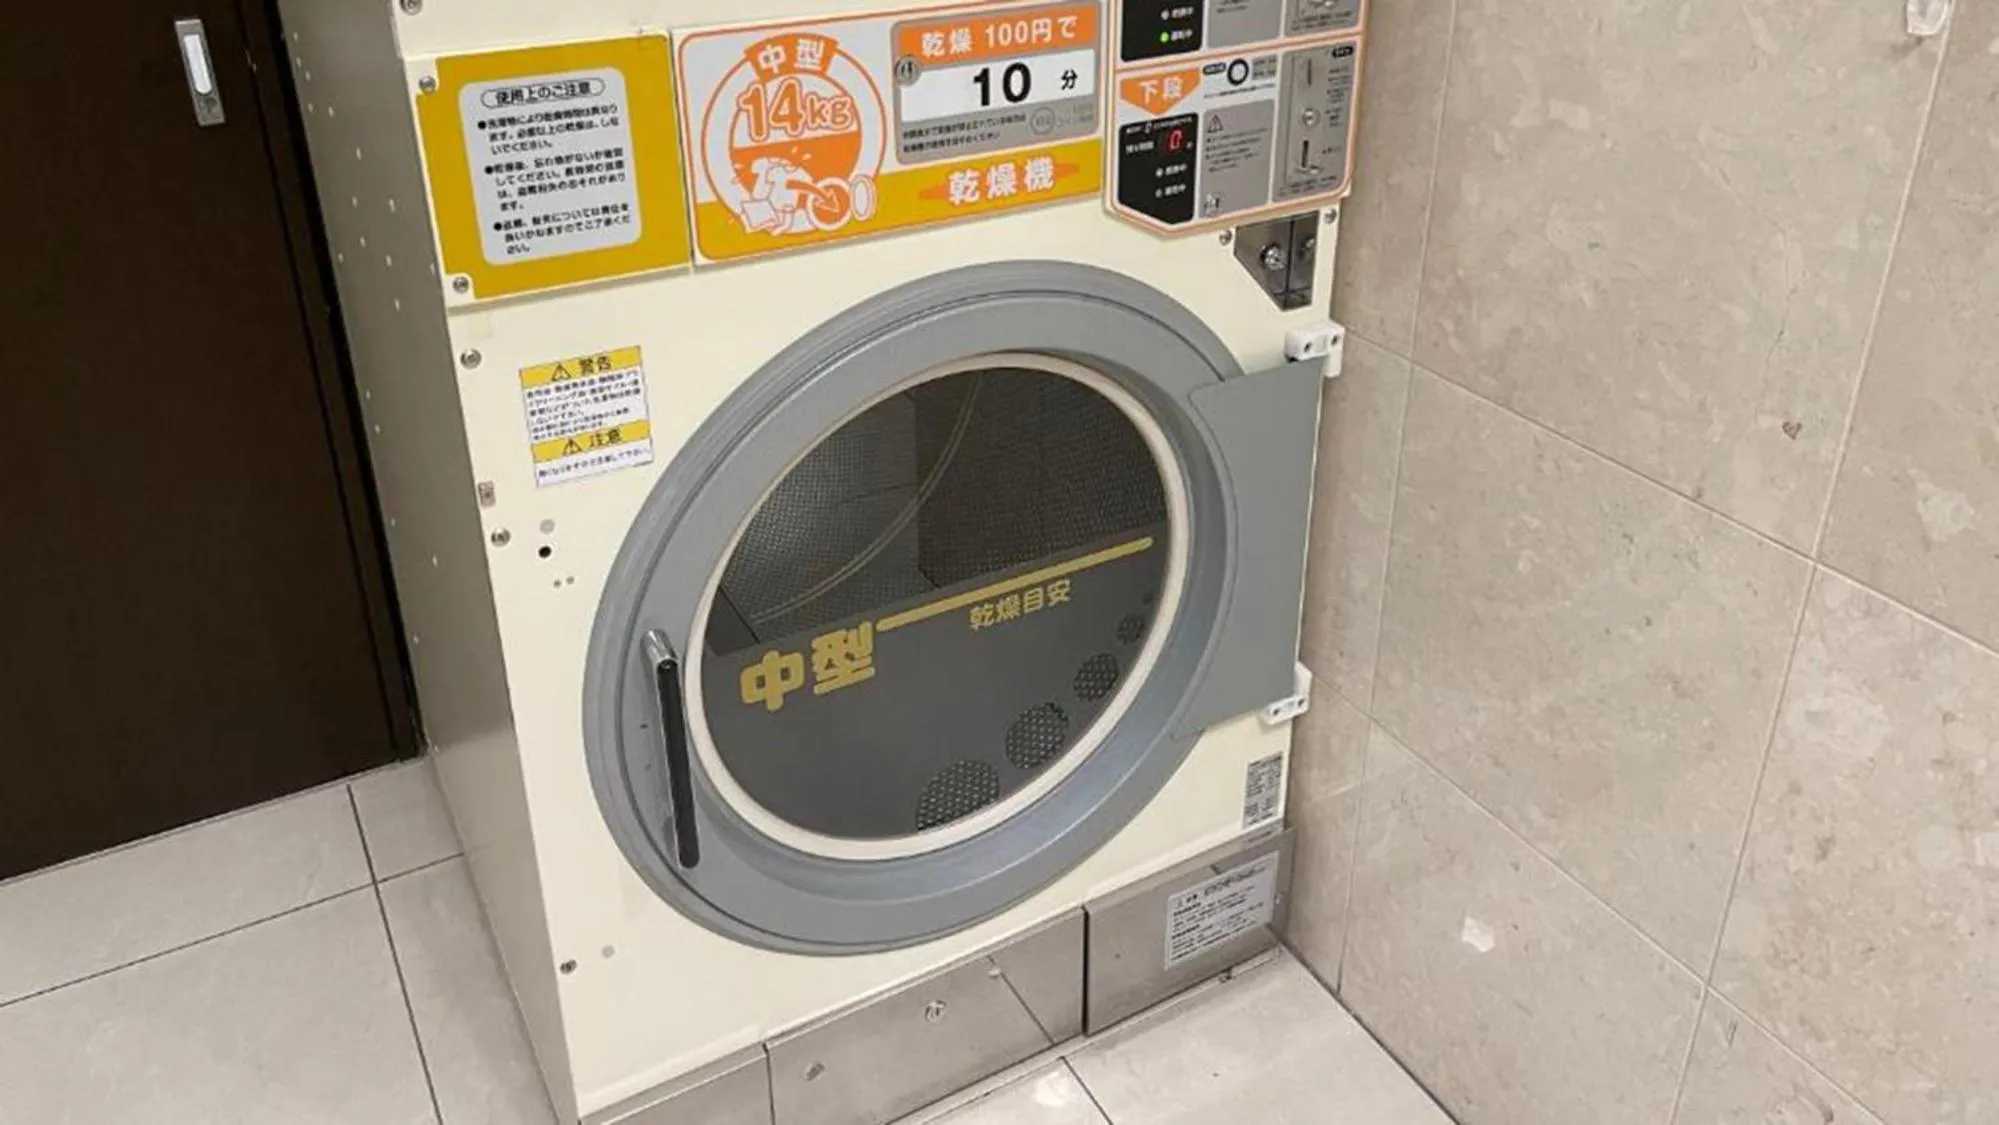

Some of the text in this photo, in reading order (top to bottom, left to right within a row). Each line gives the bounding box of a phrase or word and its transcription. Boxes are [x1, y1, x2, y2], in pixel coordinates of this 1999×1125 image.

[757, 38, 825, 74] 中型
[921, 15, 1078, 57] 乾燥 100円で
[495, 80, 592, 105] 使用上のご注意
[973, 62, 1078, 106] 10 分
[1139, 75, 1183, 104] 下段
[737, 77, 854, 142] 14kg
[948, 155, 1054, 207] 乾燥機
[589, 428, 622, 449] 注意
[968, 578, 1072, 631] 乾燥目安
[740, 620, 876, 712] 中型
